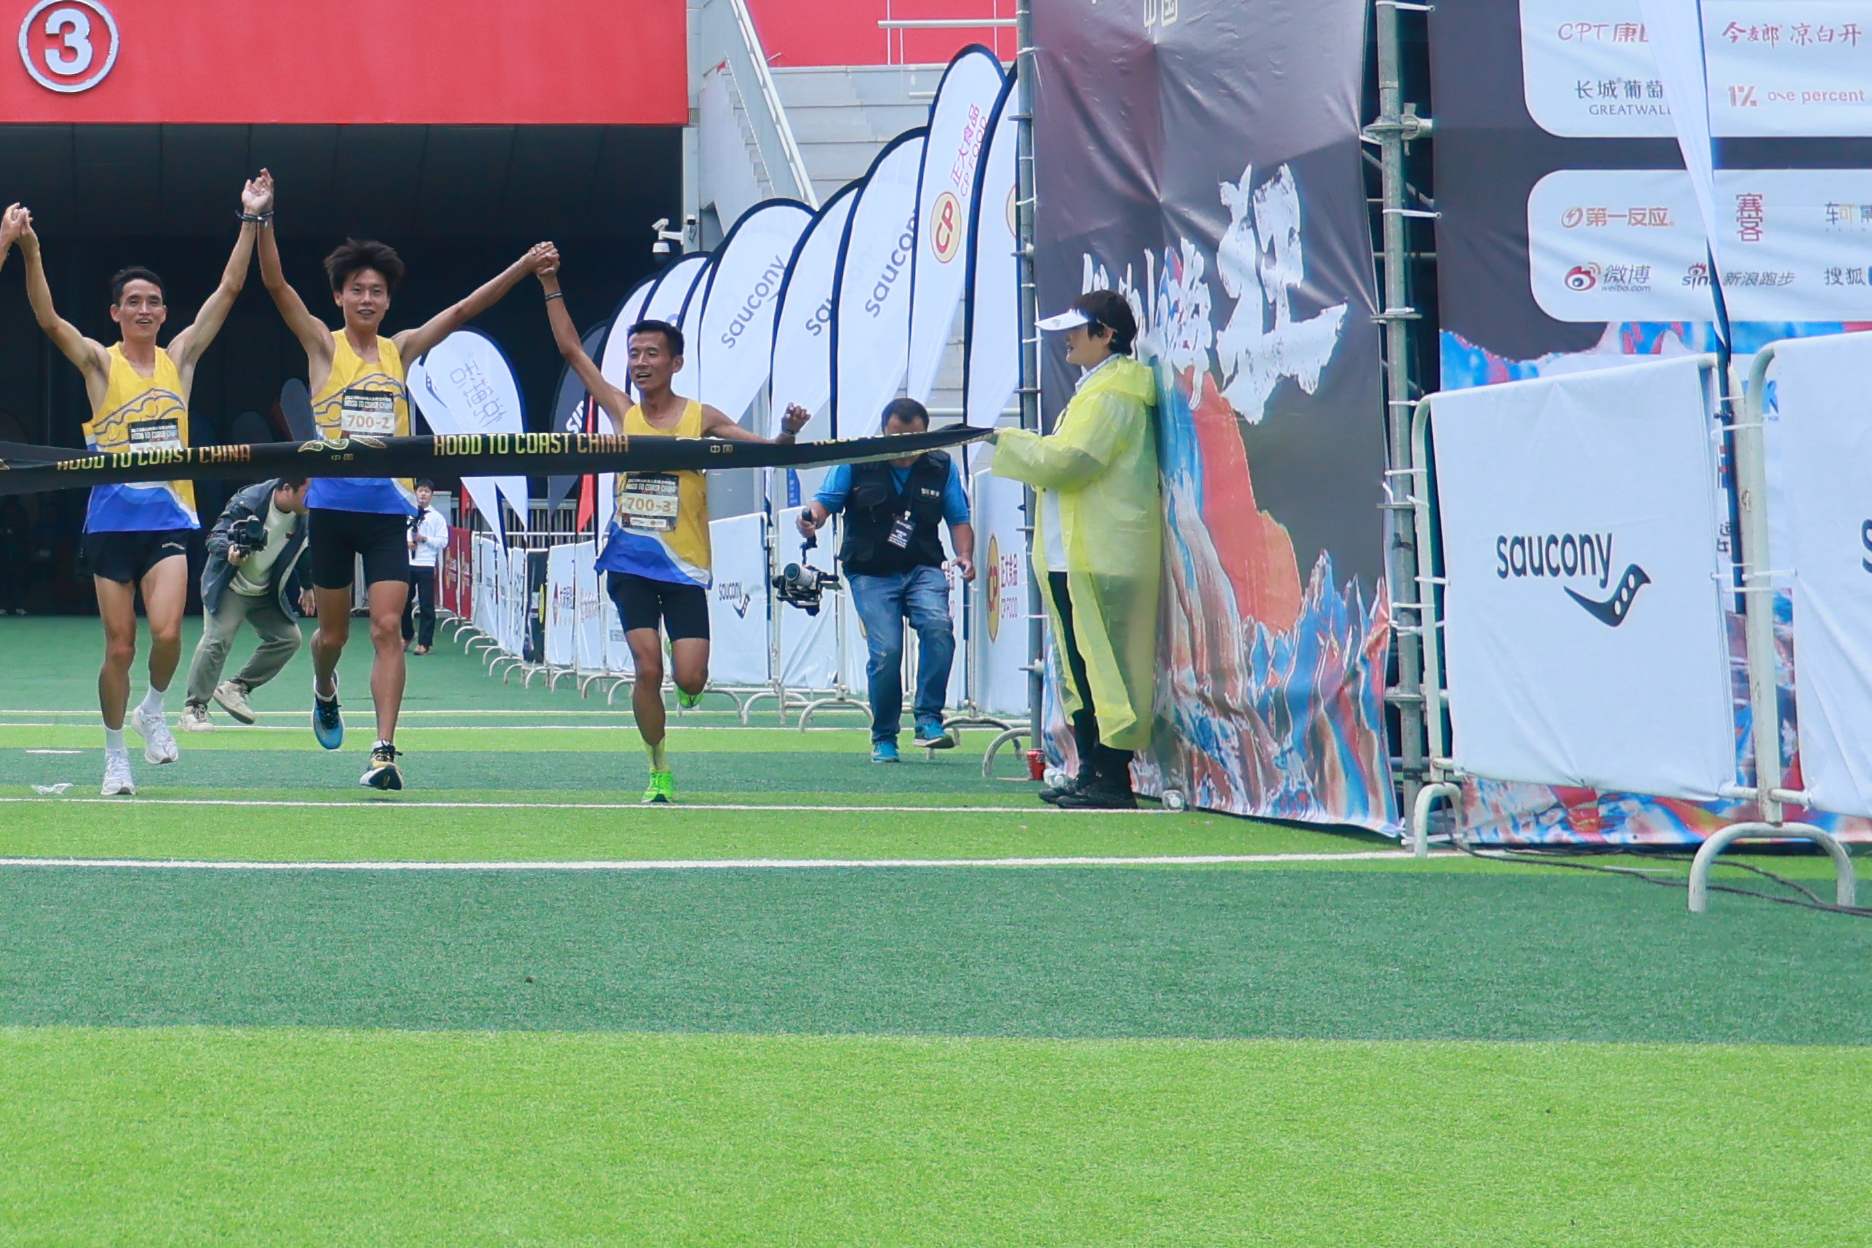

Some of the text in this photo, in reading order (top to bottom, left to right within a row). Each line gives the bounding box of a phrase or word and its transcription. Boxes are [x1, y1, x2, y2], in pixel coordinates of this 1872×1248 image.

[44, 8, 93, 75] 3
[1558, 22, 1609, 42] CPT
[1722, 21, 1862, 49] 今麦郎 凉白开
[1802, 88, 1865, 107] percent
[951, 104, 980, 188] 正大食品
[960, 174, 971, 197] CP
[935, 200, 953, 253] CP
[1586, 207, 1669, 227] 第一反应
[1736, 193, 1763, 242] 赛客
[1603, 263, 1651, 285] 微博
[1723, 272, 1795, 287] 新浪跑步
[1824, 267, 1866, 286] 搜狐
[721, 254, 787, 350] saucony
[347, 414, 389, 430] 700-2
[199, 445, 250, 464] CHINA
[433, 433, 628, 456] HOOD TO COAST CHINA
[627, 497, 672, 513] 700-3
[1496, 532, 1612, 589] saucony
